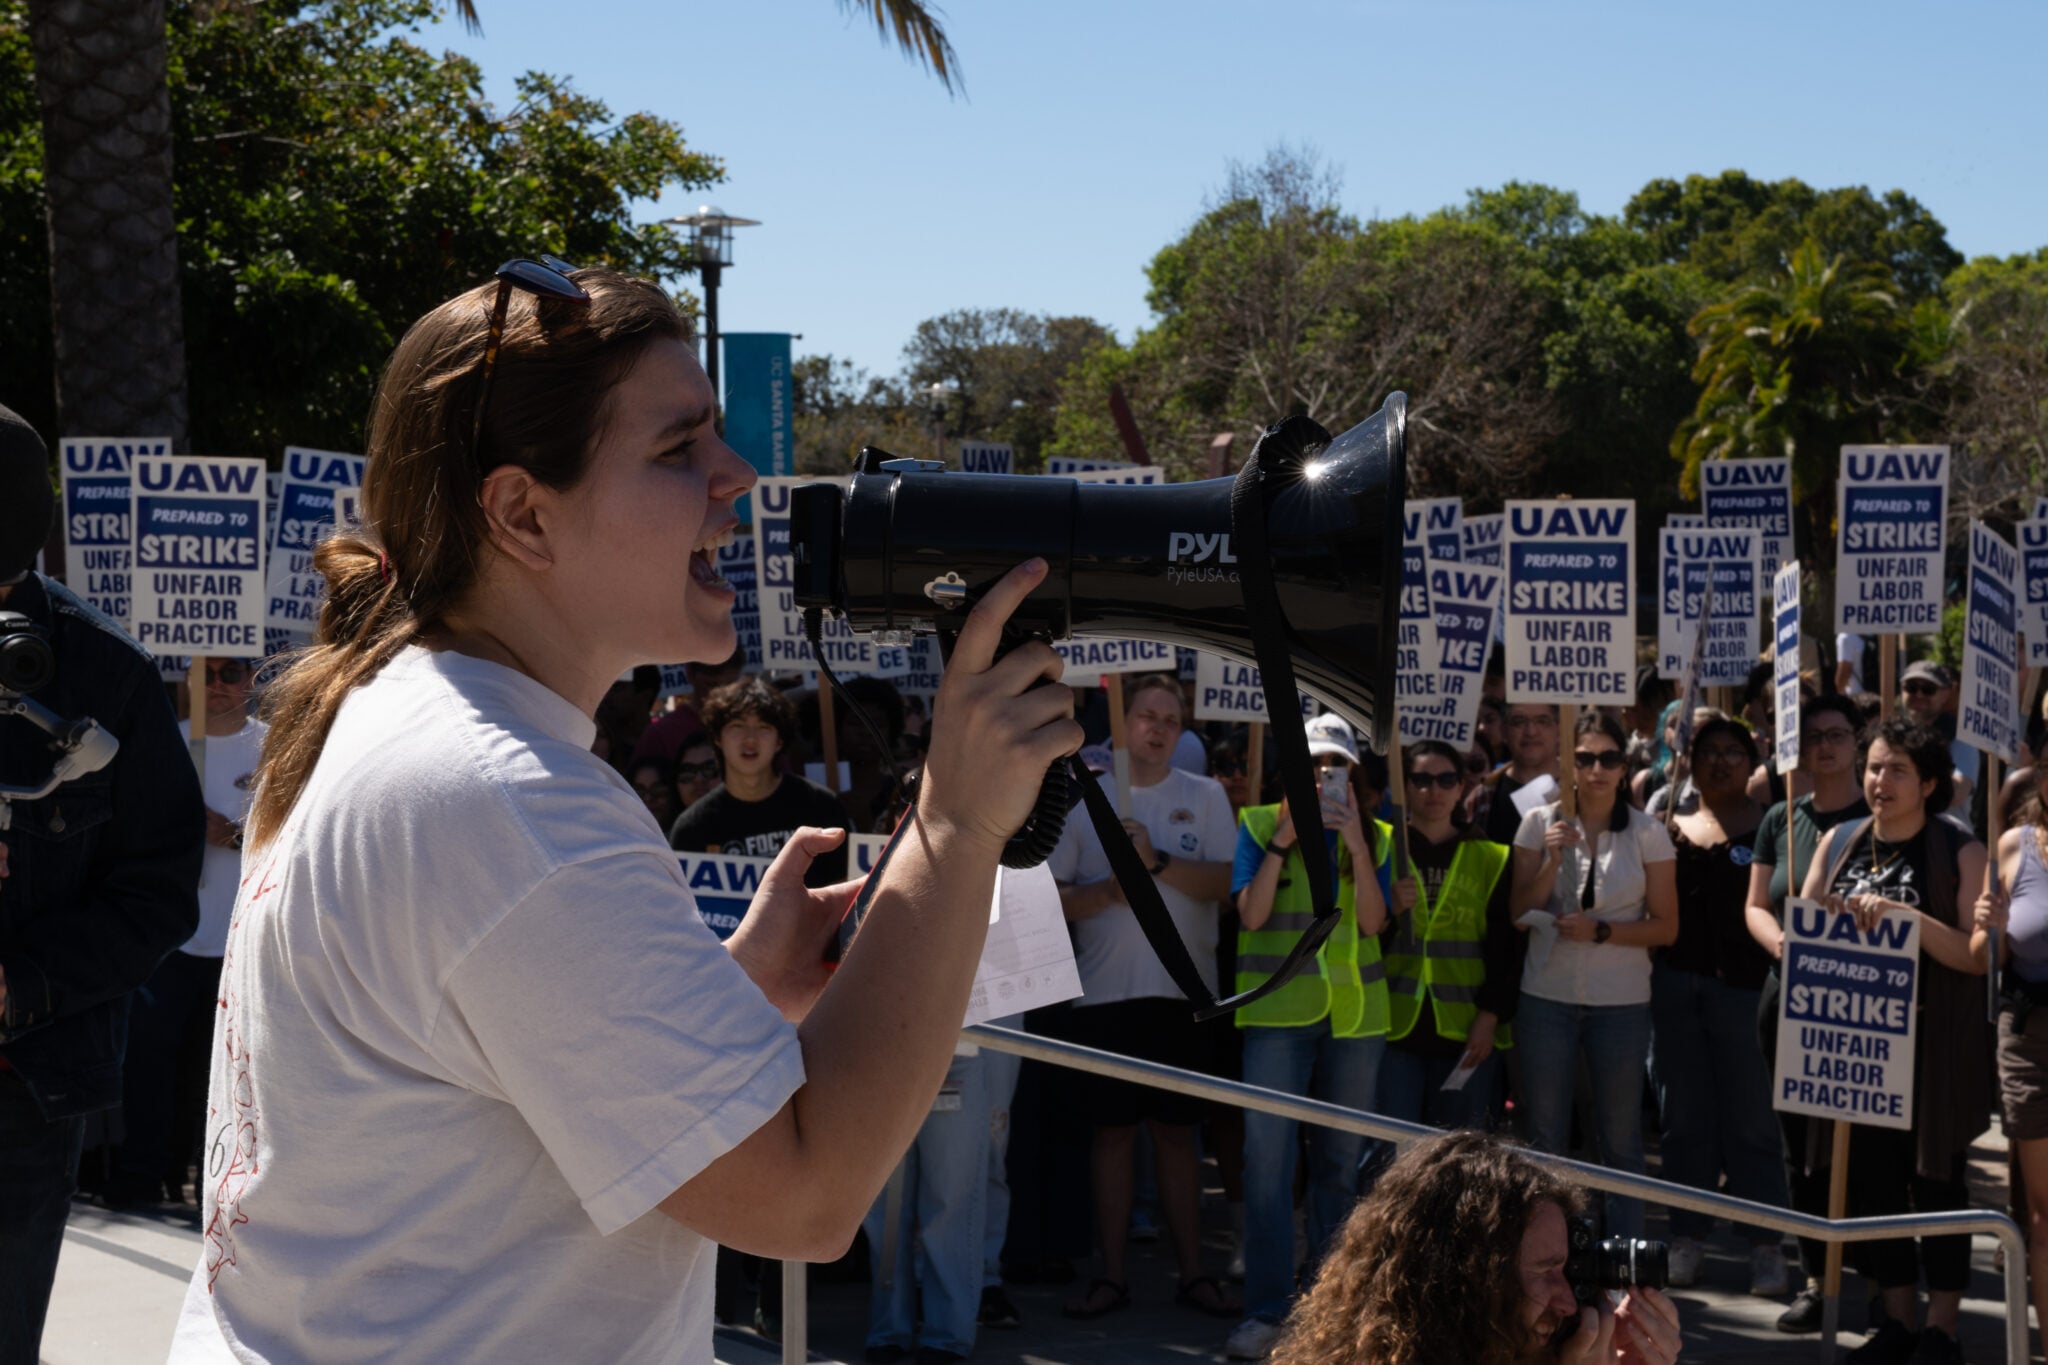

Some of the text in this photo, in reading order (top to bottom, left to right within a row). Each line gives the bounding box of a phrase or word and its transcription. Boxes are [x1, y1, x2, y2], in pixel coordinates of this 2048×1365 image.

[771, 356, 784, 377] UC
[771, 380, 785, 429] SANTA
[138, 462, 259, 494] UAW
[290, 453, 364, 486] UA
[1706, 464, 1786, 487] UAW
[1848, 453, 1943, 481] UAW
[1710, 496, 1786, 509] PREPARED TO
[1852, 499, 1931, 513] PREPARED TO
[72, 512, 130, 541] STRI
[152, 508, 248, 526] PREPARED TO
[1512, 506, 1628, 537] UAW
[1168, 531, 1238, 563] PYL
[1683, 536, 1751, 559] UAW
[1846, 520, 1939, 549] STRIKE
[140, 533, 257, 565] STRIKE
[1523, 553, 1617, 569] PREPARED TO
[1974, 527, 2015, 585] UAW
[1857, 556, 1928, 577] UNFAIR
[153, 573, 242, 596] UNFAIR
[1513, 580, 1624, 611] STRIKE
[1861, 581, 1923, 601] LABOR
[158, 599, 237, 620] LABOR
[1843, 603, 1938, 625] PRACTICE
[139, 621, 257, 646] PRACTICE
[1526, 620, 1611, 643] UNFAIR
[1697, 621, 1748, 639] NFAIR
[1531, 645, 1607, 668] LABOR
[1513, 670, 1626, 694] PRACTICE
[679, 858, 768, 893] AW
[1793, 906, 1914, 951] UAW
[1796, 953, 1909, 988] PREPARED TO
[1789, 983, 1905, 1029] STRIKE
[1801, 1026, 1890, 1061] UNFAIR
[1804, 1053, 1884, 1088] LABOR
[1783, 1077, 1904, 1118] PRACTICE
